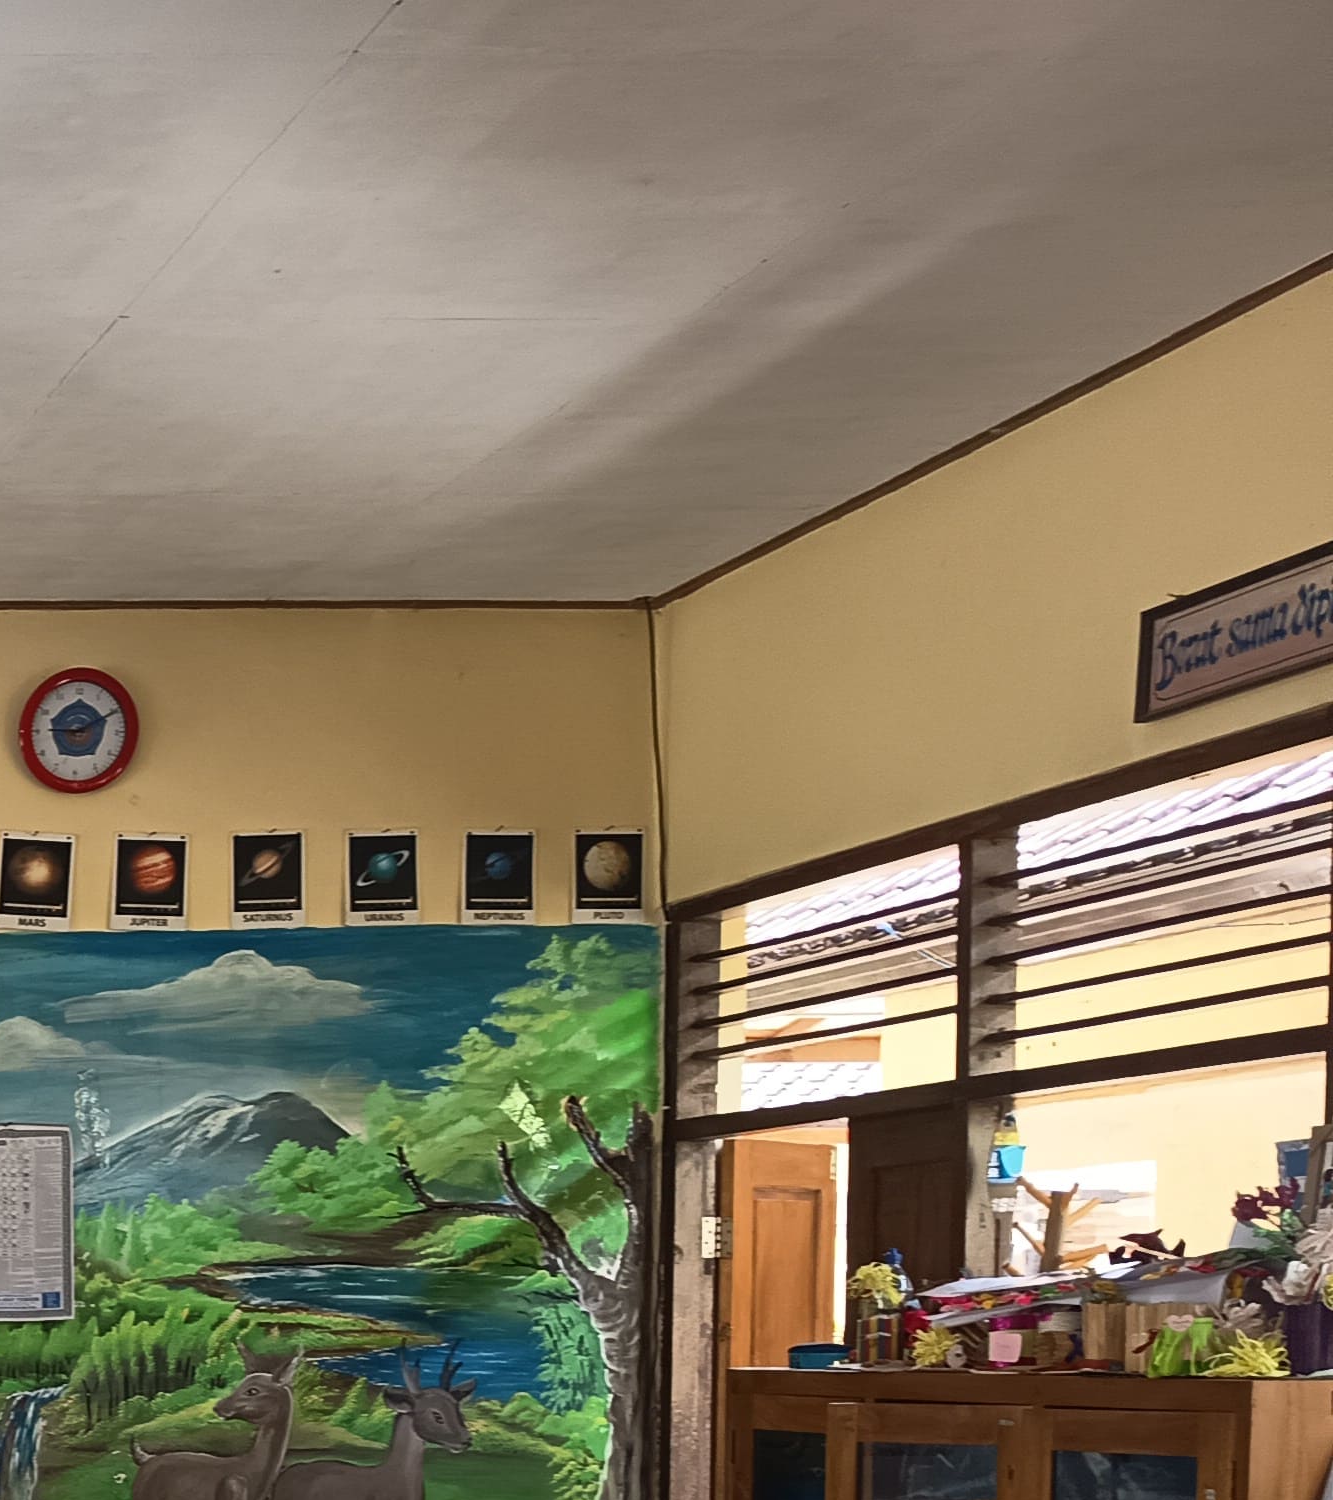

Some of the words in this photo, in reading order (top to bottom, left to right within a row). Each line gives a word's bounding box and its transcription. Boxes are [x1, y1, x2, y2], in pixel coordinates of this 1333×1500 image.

[243, 912, 294, 924] SATURNUS
[364, 912, 405, 922] URANUS
[473, 912, 525, 921] NEPTUNUS
[593, 911, 625, 920] PLUTO
[18, 918, 47, 928] MARS
[130, 917, 169, 928] JUPITER
